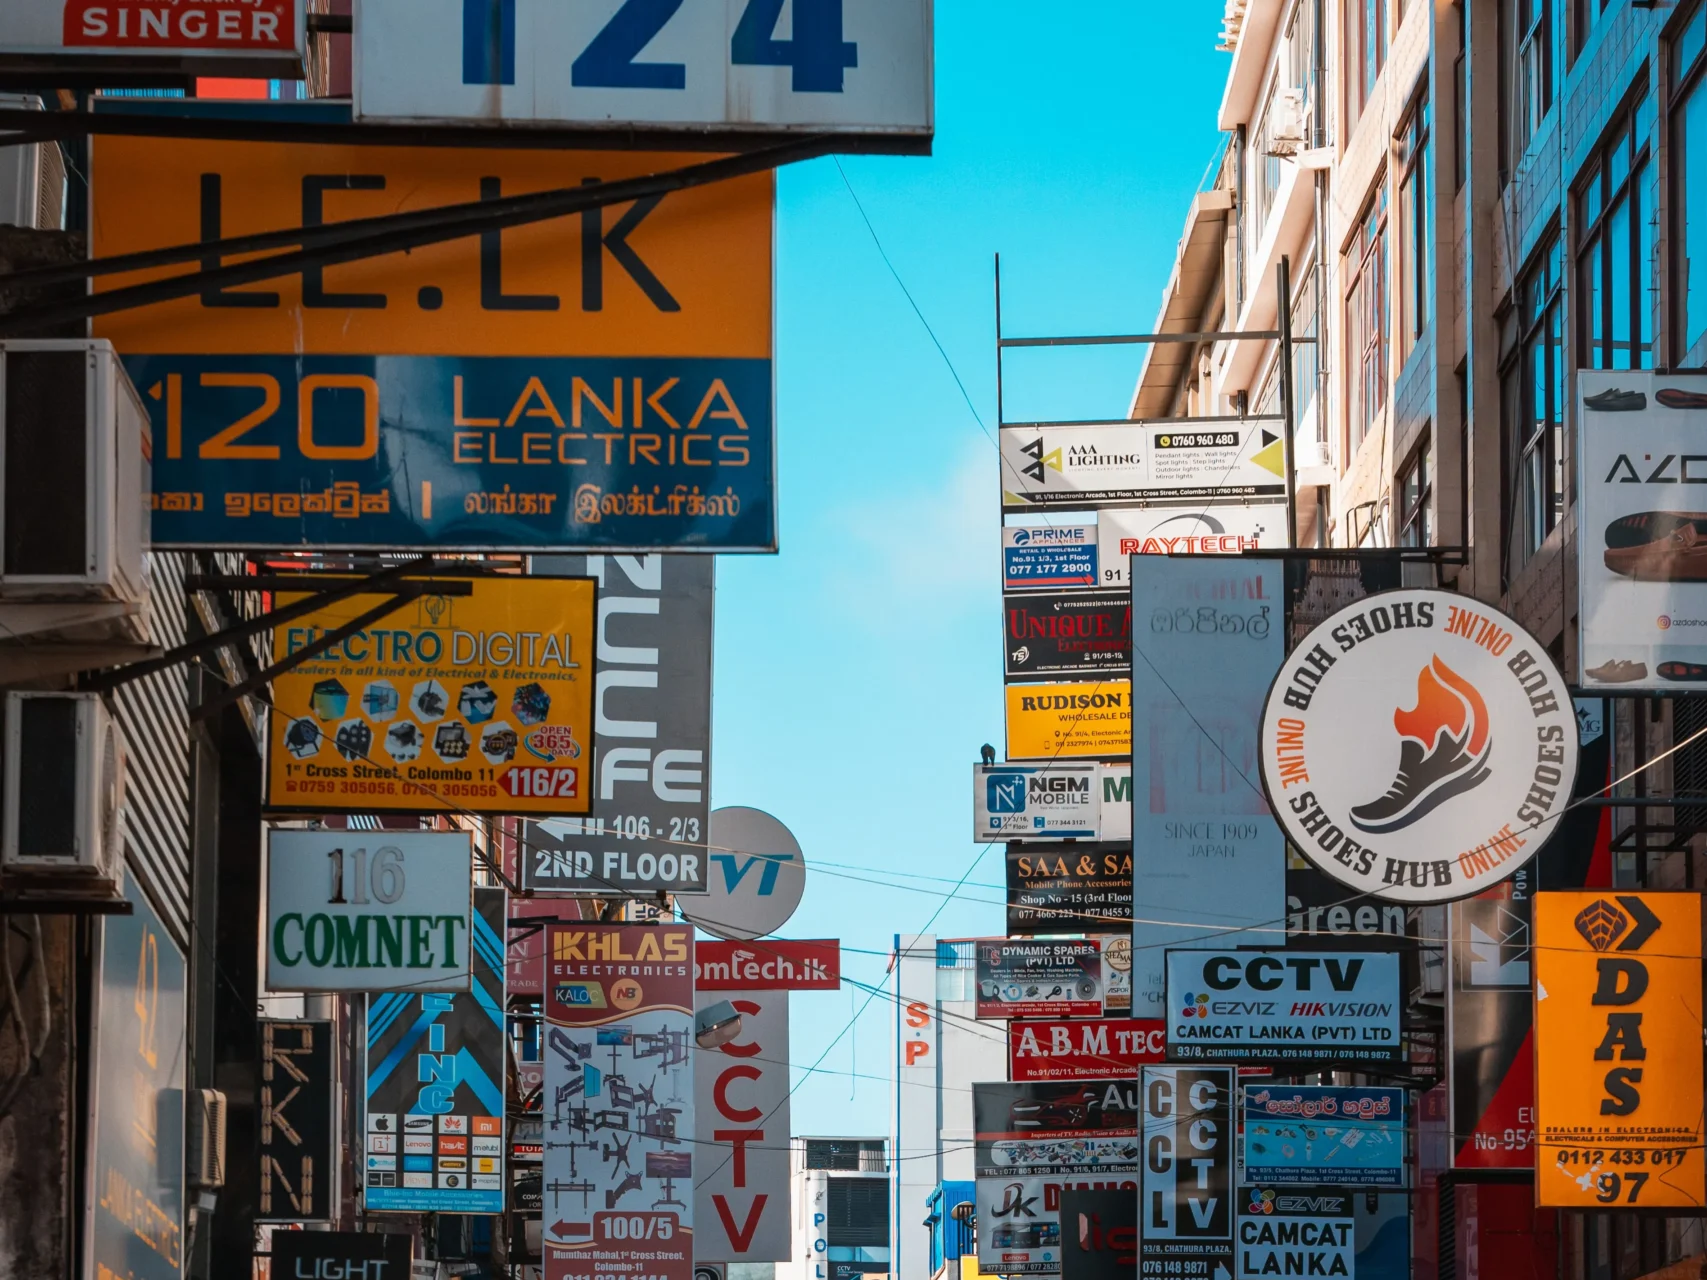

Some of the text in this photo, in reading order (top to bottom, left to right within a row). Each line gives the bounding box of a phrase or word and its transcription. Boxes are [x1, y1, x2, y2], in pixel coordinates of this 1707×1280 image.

[82, 7, 279, 41] SINGER
[200, 173, 681, 312] LE.LK
[453, 375, 749, 430] LANKA
[163, 373, 379, 460] 120
[453, 432, 750, 467] ELECTRICS
[1068, 444, 1097, 455] AAA
[1172, 433, 1234, 447] 0760 960 480
[1068, 454, 1141, 467] LIGHTING
[1031, 529, 1085, 541] PRIME
[1120, 535, 1260, 555] RAYTECH
[1010, 562, 1092, 575] 077 177 2900
[1009, 608, 1114, 640] UNIQUE
[1331, 601, 1435, 653] SHOES
[1444, 604, 1514, 657] ONLINE
[287, 628, 580, 669] ELECTRO DIGITAL
[426, 667, 487, 680] Electrical
[1283, 643, 1337, 712] HUB
[1506, 649, 1560, 718] HUB
[1022, 693, 1122, 712] RUDISON
[1058, 713, 1117, 722] WHOLESALE
[533, 733, 572, 750] 365
[539, 725, 572, 736] OPEN
[550, 748, 575, 758] DAYS
[1276, 717, 1310, 790] ONLINE
[306, 764, 473, 781] Cross Street, Colombo
[507, 768, 576, 797] 116/2
[1029, 777, 1089, 792] NGM
[1516, 724, 1565, 829] SHOES
[443, 784, 497, 797] 305056
[1029, 792, 1089, 805] MOBILE
[612, 815, 700, 842] 106 2/3
[1164, 822, 1258, 840] SINCE 1909
[1288, 790, 1379, 876] SHOES
[1187, 845, 1235, 858] JAPAN
[1458, 823, 1528, 880] ONLINE
[327, 846, 406, 905] 116
[534, 850, 700, 882] 2ND FLOOR
[710, 854, 794, 897] VT
[1018, 855, 1069, 878] SAA
[1381, 857, 1453, 888] HUB
[1020, 894, 1045, 905] Shop
[272, 912, 466, 969] COMNET
[553, 931, 688, 962] IKHLAS
[1002, 945, 1095, 957] DYNAMIC SPARES
[554, 965, 687, 976] ELECTRONICS
[1202, 956, 1365, 993] CCTV
[1212, 1001, 1392, 1017] EZVIZ HIKVISION
[1016, 1025, 1110, 1058] A.B.M
[1176, 1025, 1392, 1042] CAMCAT LANKA (PVT) LTD
[1591, 957, 1650, 1117] DAS
[1177, 1046, 1250, 1059] 93/8, CHATHURA
[260, 1022, 314, 1215] RKN
[711, 1000, 769, 1253] CCTV
[1187, 1080, 1218, 1229] CCTV
[1557, 1149, 1687, 1165] 0112 433 017
[984, 1168, 999, 1176] TEL
[1596, 1172, 1650, 1203] 97
[1276, 1196, 1343, 1213] EZVIZ
[600, 1216, 674, 1241] 100/5
[1240, 1221, 1353, 1248] CAMCAT
[553, 1250, 592, 1260] Mumthaz
[1164, 1244, 1204, 1254] CHATHURA
[594, 1261, 644, 1272] Colombo-11
[1142, 1260, 1208, 1274] 076 148 9871
[1244, 1251, 1351, 1276] LANKA
